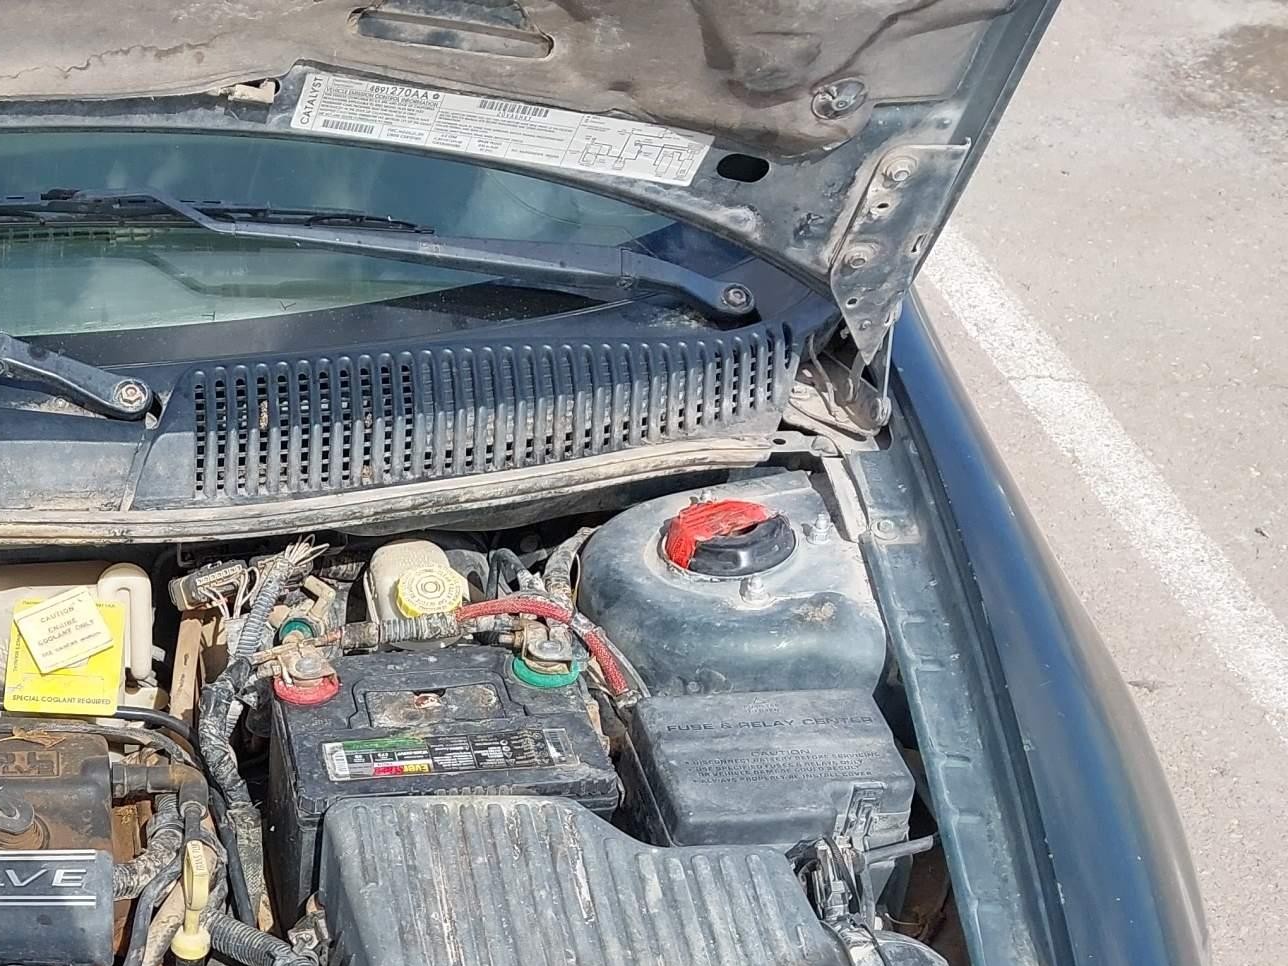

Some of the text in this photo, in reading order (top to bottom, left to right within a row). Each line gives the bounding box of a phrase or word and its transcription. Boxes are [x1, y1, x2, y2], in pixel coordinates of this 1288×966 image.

[300, 77, 322, 125] CATALYST
[374, 93, 401, 103] CONTROL
[401, 97, 439, 108] INFORMATION
[40, 606, 75, 624] CAUTION
[12, 694, 111, 705] SPECIAL COOLANT REQUIRED
[666, 723, 714, 732] FUSE
[738, 719, 795, 729] RELAY
[802, 716, 873, 726] CENTER
[750, 748, 811, 757] CAUTION
